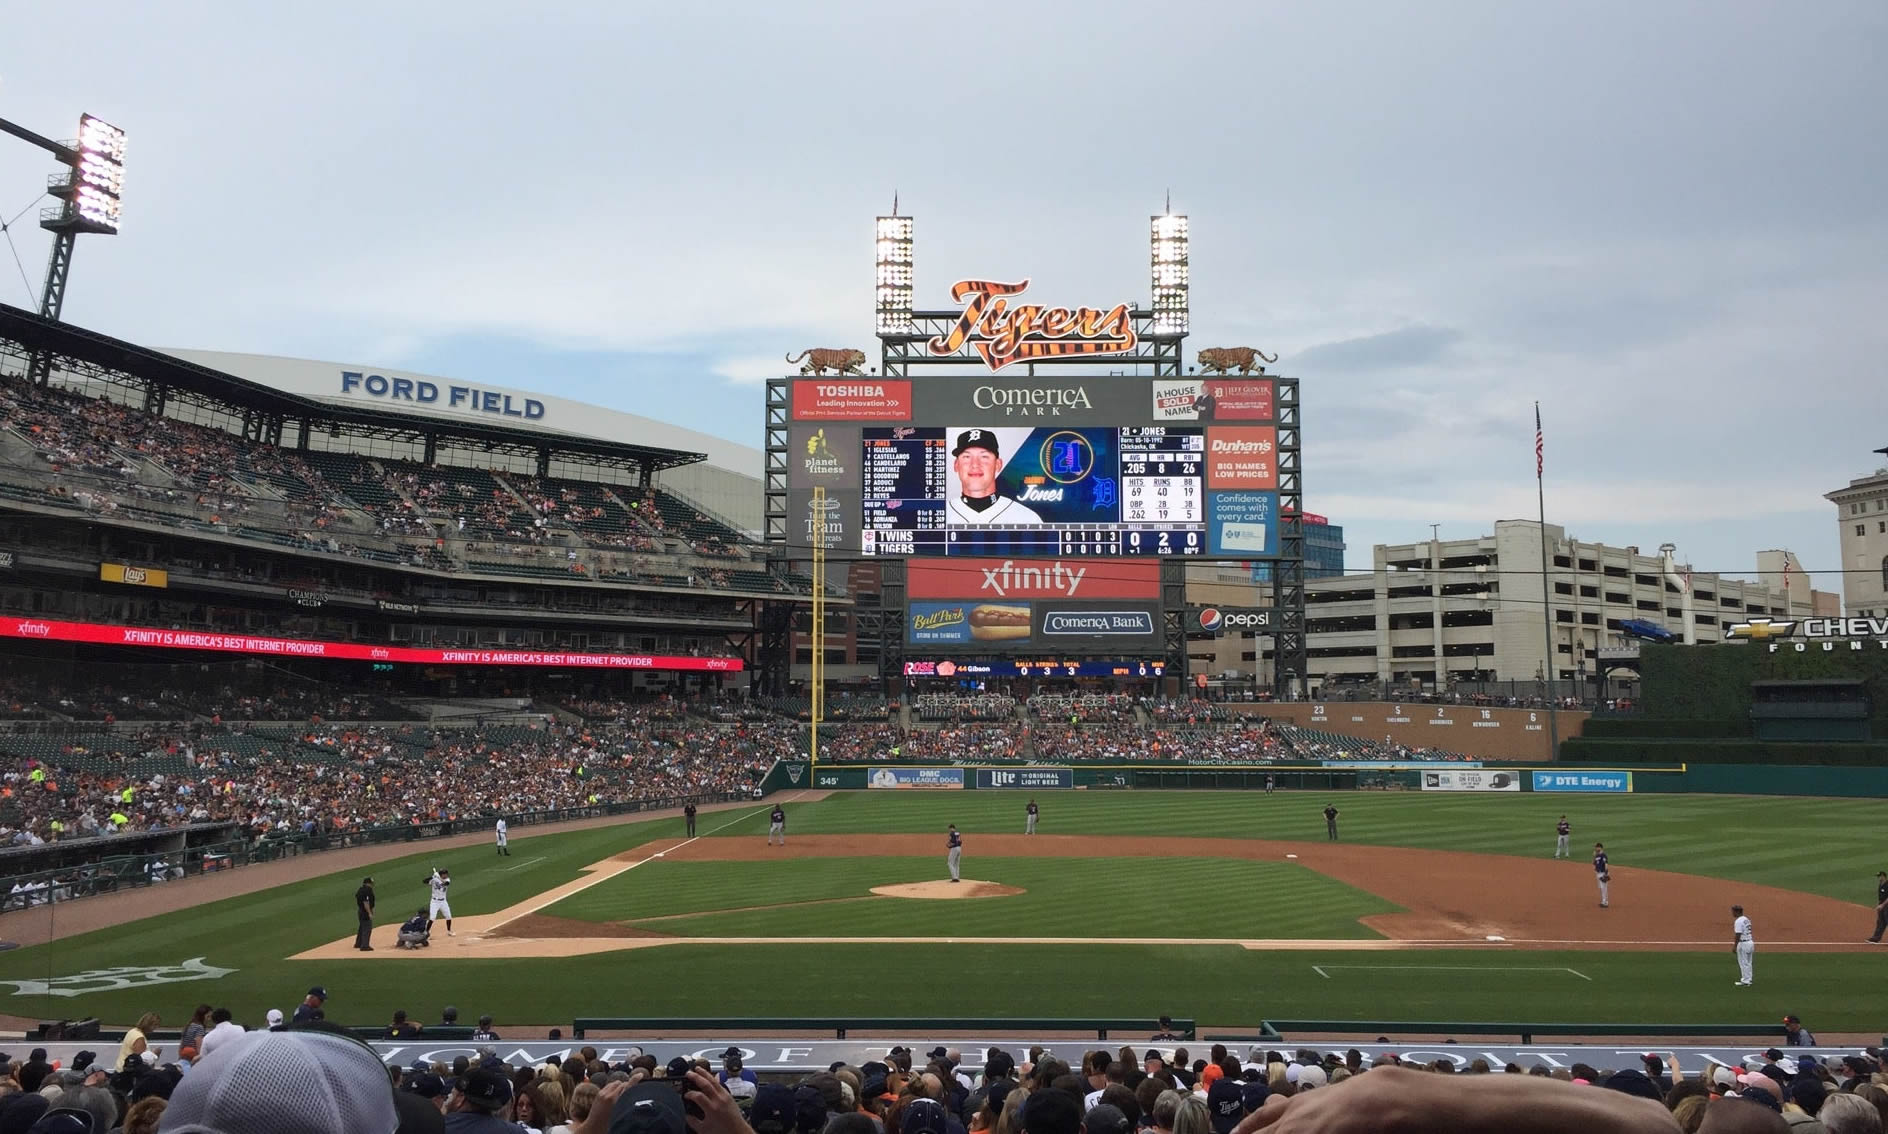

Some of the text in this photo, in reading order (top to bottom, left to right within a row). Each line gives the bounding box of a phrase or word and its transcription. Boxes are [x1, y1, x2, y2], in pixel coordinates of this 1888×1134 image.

[928, 277, 1137, 373] Tigers
[341, 371, 546, 420] FORD FIELD
[817, 386, 884, 397] TOSHIBA
[1156, 387, 1195, 399] A HOUSE
[817, 400, 845, 408] Leading
[1163, 397, 1189, 407] SOLD
[1006, 407, 1060, 416] PARK
[1164, 406, 1192, 416] NAME
[1122, 428, 1165, 436] 21 JONES
[1211, 439, 1272, 452] Dunham's
[805, 457, 837, 470] planet
[1053, 442, 1081, 474] 21
[809, 465, 844, 475] fitness
[1123, 463, 1145, 474] .205
[1158, 463, 1165, 474] 8
[1182, 463, 1195, 474] 26
[1017, 485, 1064, 501] Jones
[1131, 487, 1142, 497] 69
[1157, 487, 1167, 497] 40
[1184, 487, 1193, 497] 19
[1216, 494, 1268, 503] Confidence
[1248, 503, 1268, 512] with
[1128, 510, 1145, 519] .262
[1159, 510, 1168, 519] 19
[1186, 510, 1192, 519] 5
[1216, 514, 1242, 522] every
[880, 531, 1115, 543] TWINS 0 0 1 0 3
[1130, 532, 1140, 546] 0
[1158, 532, 1168, 546] 2
[1186, 532, 1197, 546] 0
[880, 544, 1116, 555] TIGERS 0 0 0 0
[980, 560, 1087, 596] xfinity
[289, 588, 329, 602] CHAMPIONS
[912, 608, 964, 629] Ball Park
[1113, 617, 1145, 628] Bank
[1224, 612, 1269, 628] pepsi
[1803, 618, 1888, 637] CHEV
[17, 621, 325, 655] xfinity XFINITY IS AMERICA'S BEST INTERNET PROVIDER
[442, 651, 481, 662] XFINITY
[482, 653, 491, 662] IS
[492, 653, 542, 664] AMERICA'S
[543, 654, 565, 664] BEST
[567, 655, 608, 665] INTERNET
[610, 657, 653, 667] PROVIDER
[903, 662, 936, 675] ROSE
[1021, 667, 1027, 675] 0
[1044, 667, 1050, 675] 3
[1068, 667, 1075, 675] 3
[1139, 667, 1145, 675] 0
[1155, 667, 1161, 675] 6
[1314, 705, 1324, 714] 23
[1438, 708, 1444, 717] 2
[1481, 710, 1490, 719] 16
[1530, 713, 1537, 721] 6
[1188, 759, 1272, 767] MotorCityCasino.com
[991, 771, 1016, 787] Lite
[1556, 776, 1621, 787] DTE Energy
